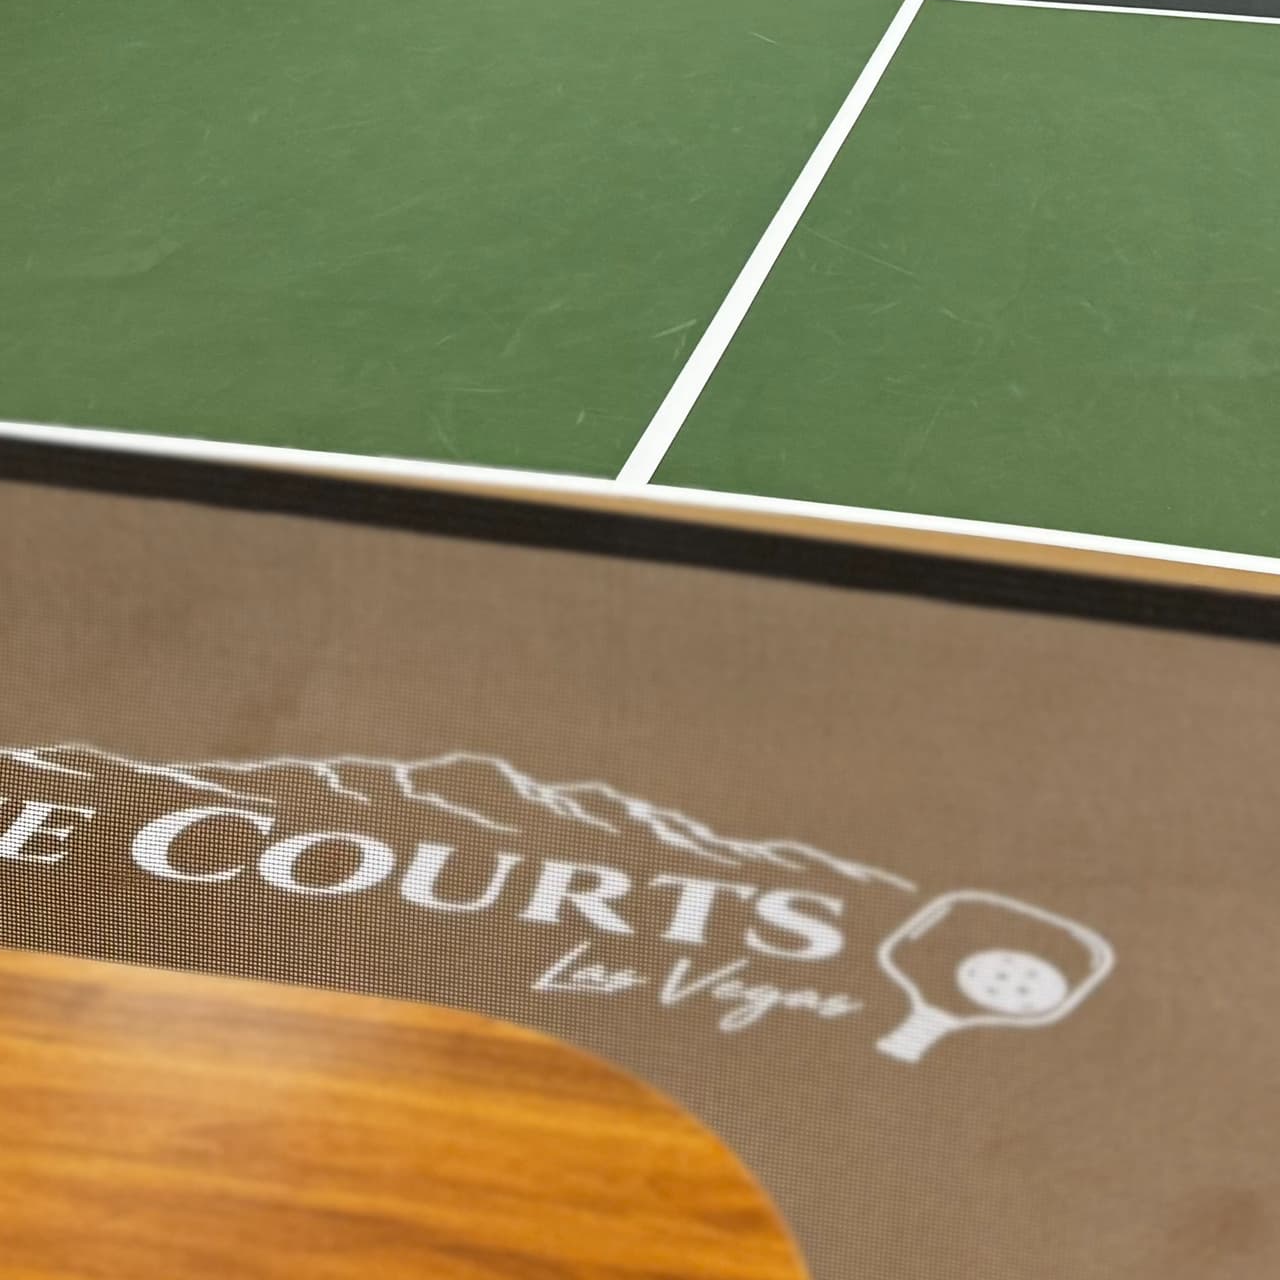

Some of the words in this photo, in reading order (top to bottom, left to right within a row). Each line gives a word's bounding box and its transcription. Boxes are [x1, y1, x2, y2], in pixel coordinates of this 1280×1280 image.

[131, 806, 844, 961] COURTS
[530, 938, 649, 994] Las
[660, 957, 865, 1035] Vegas
